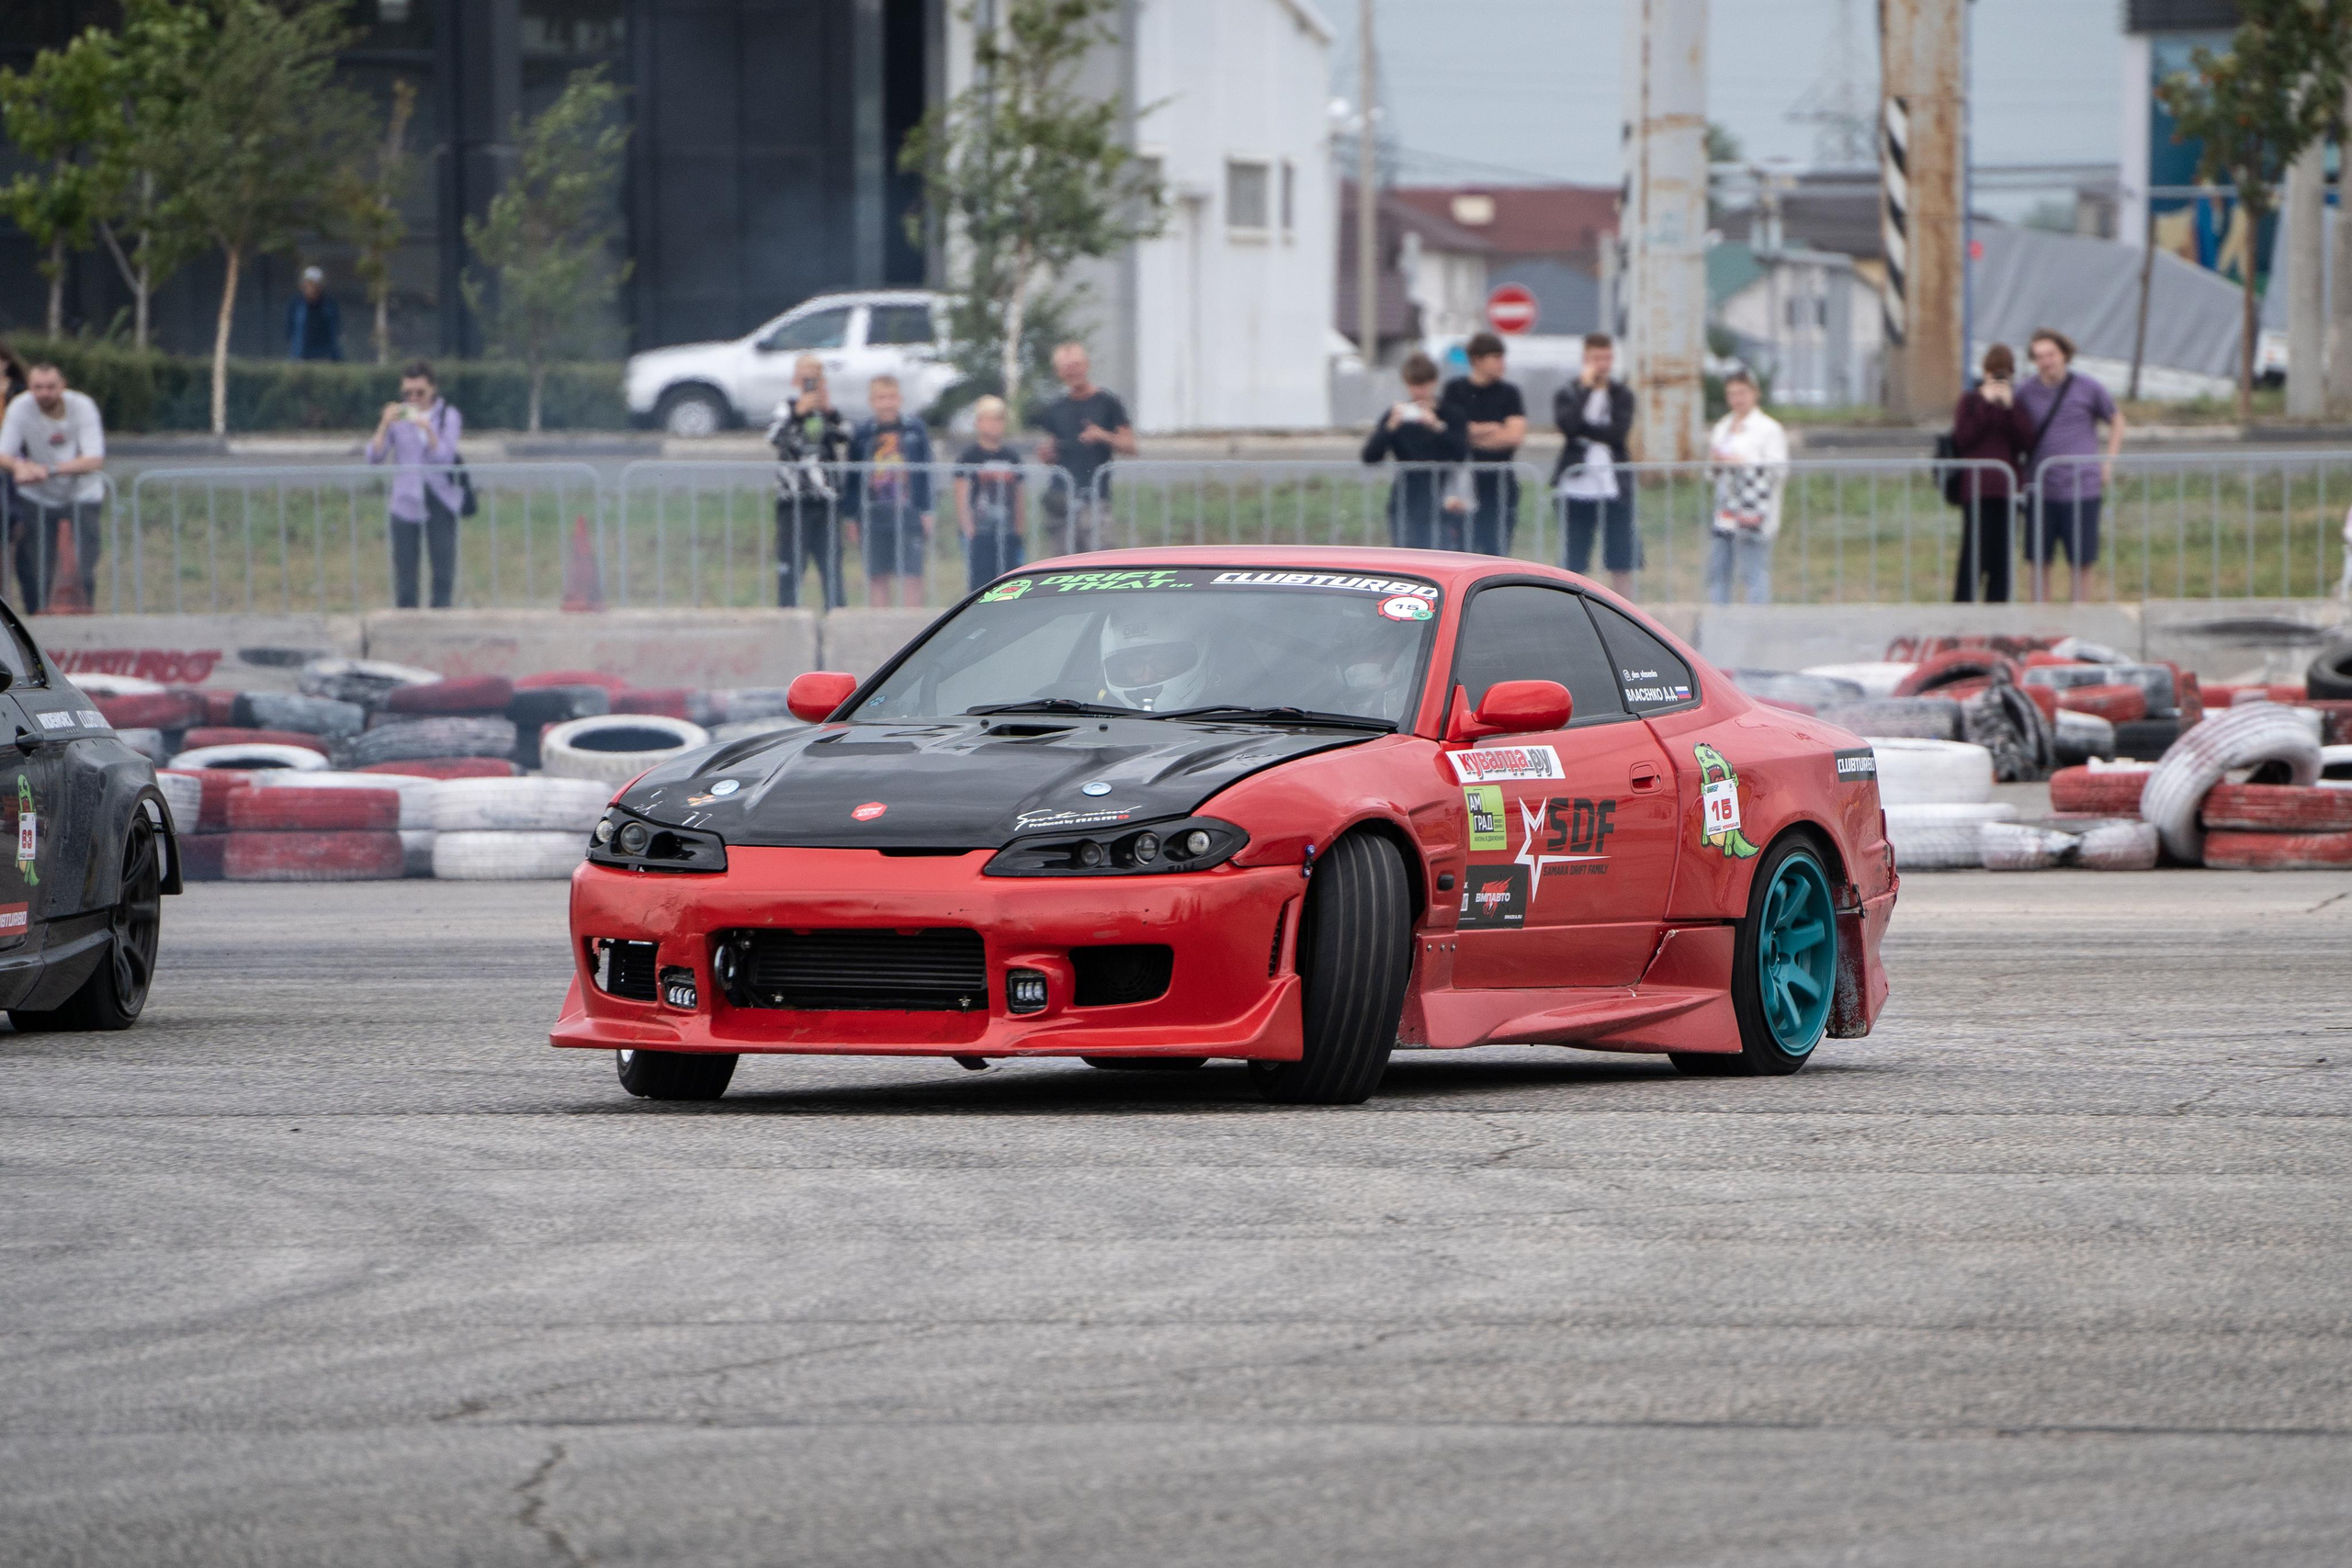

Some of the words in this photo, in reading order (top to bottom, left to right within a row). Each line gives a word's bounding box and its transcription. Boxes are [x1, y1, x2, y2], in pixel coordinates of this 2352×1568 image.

[1038, 570, 1178, 585] DRIFT
[1213, 572, 1439, 598] CLUBTURBO
[1624, 687, 1664, 702] ВЛАСЕНКО
[1457, 749, 1553, 779] кувалда.ру
[1838, 757, 1875, 773] CLUBTURBO
[1469, 795, 1483, 811] АМ
[1711, 798, 1733, 821] 15
[1029, 819, 1064, 828] Produced
[1075, 814, 1130, 823] nismo
[1474, 815, 1494, 831] ГРАД
[1547, 797, 1617, 853] SDF
[1543, 865, 1569, 876] SAMARA
[1569, 864, 1588, 875] DRIFT
[1588, 863, 1610, 874] FAMILY
[1476, 892, 1511, 902] ВМПАВТО
